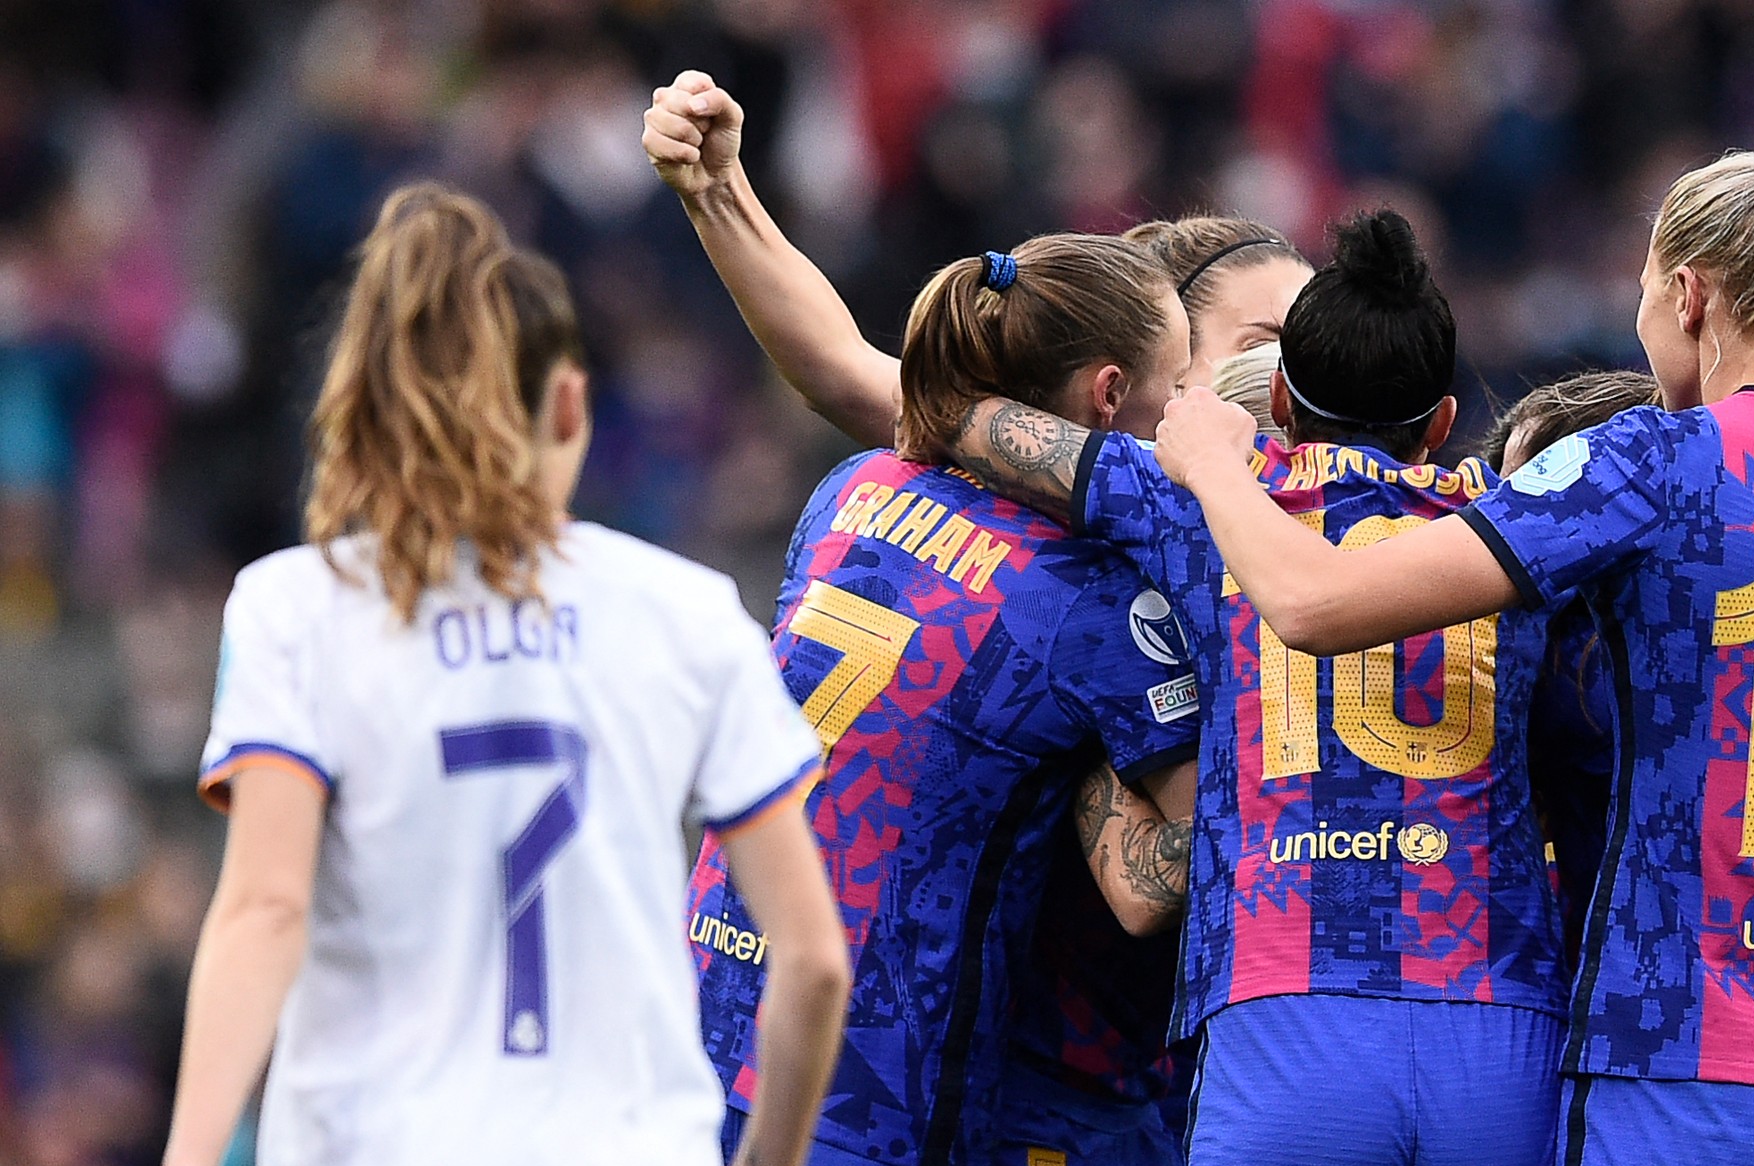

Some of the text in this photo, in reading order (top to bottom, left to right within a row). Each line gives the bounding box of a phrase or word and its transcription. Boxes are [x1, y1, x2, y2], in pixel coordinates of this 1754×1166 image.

[830, 480, 1011, 594] GRAHAM
[434, 602, 578, 669] OLGA
[789, 580, 920, 762] 7
[1221, 509, 1498, 780] 10
[439, 719, 589, 1057] 7
[1269, 821, 1395, 865] unicef
